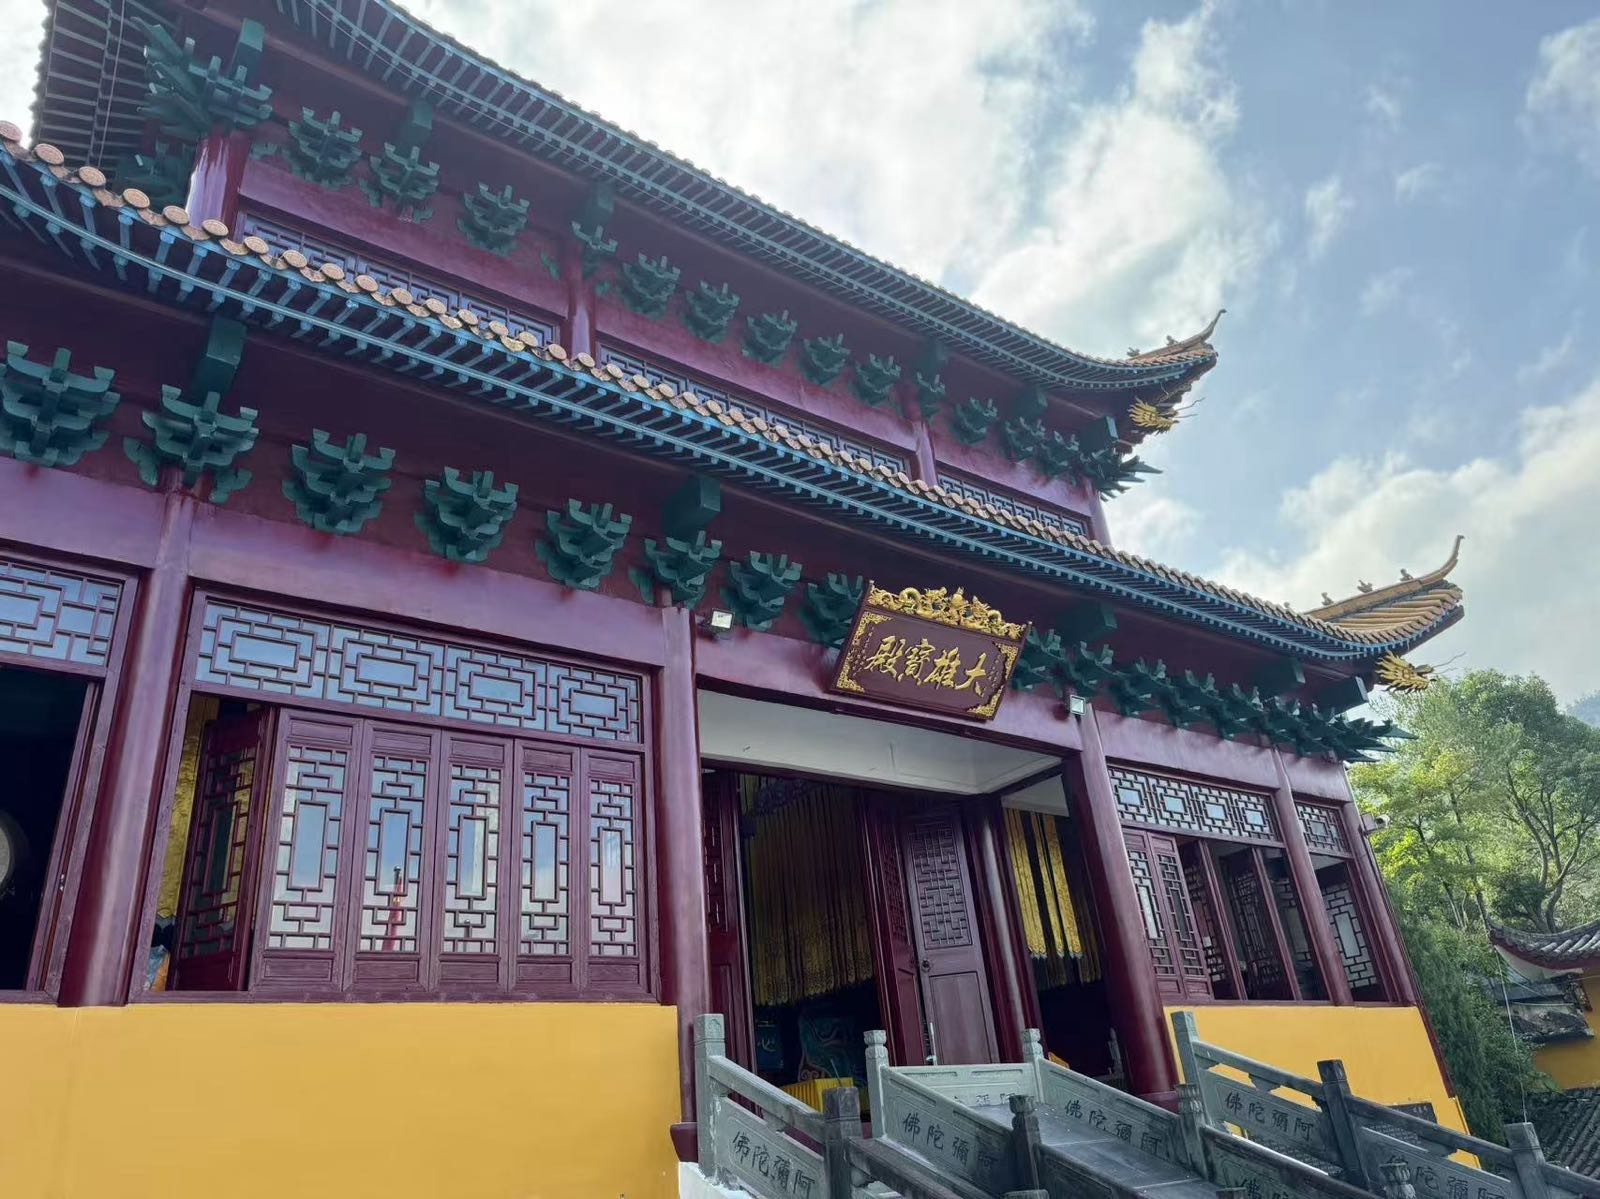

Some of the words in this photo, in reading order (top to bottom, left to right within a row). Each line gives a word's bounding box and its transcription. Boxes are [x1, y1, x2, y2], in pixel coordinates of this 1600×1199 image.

[864, 635, 987, 698] 大雄寶殿
[1225, 1090, 1314, 1141] 阿彌陀佛
